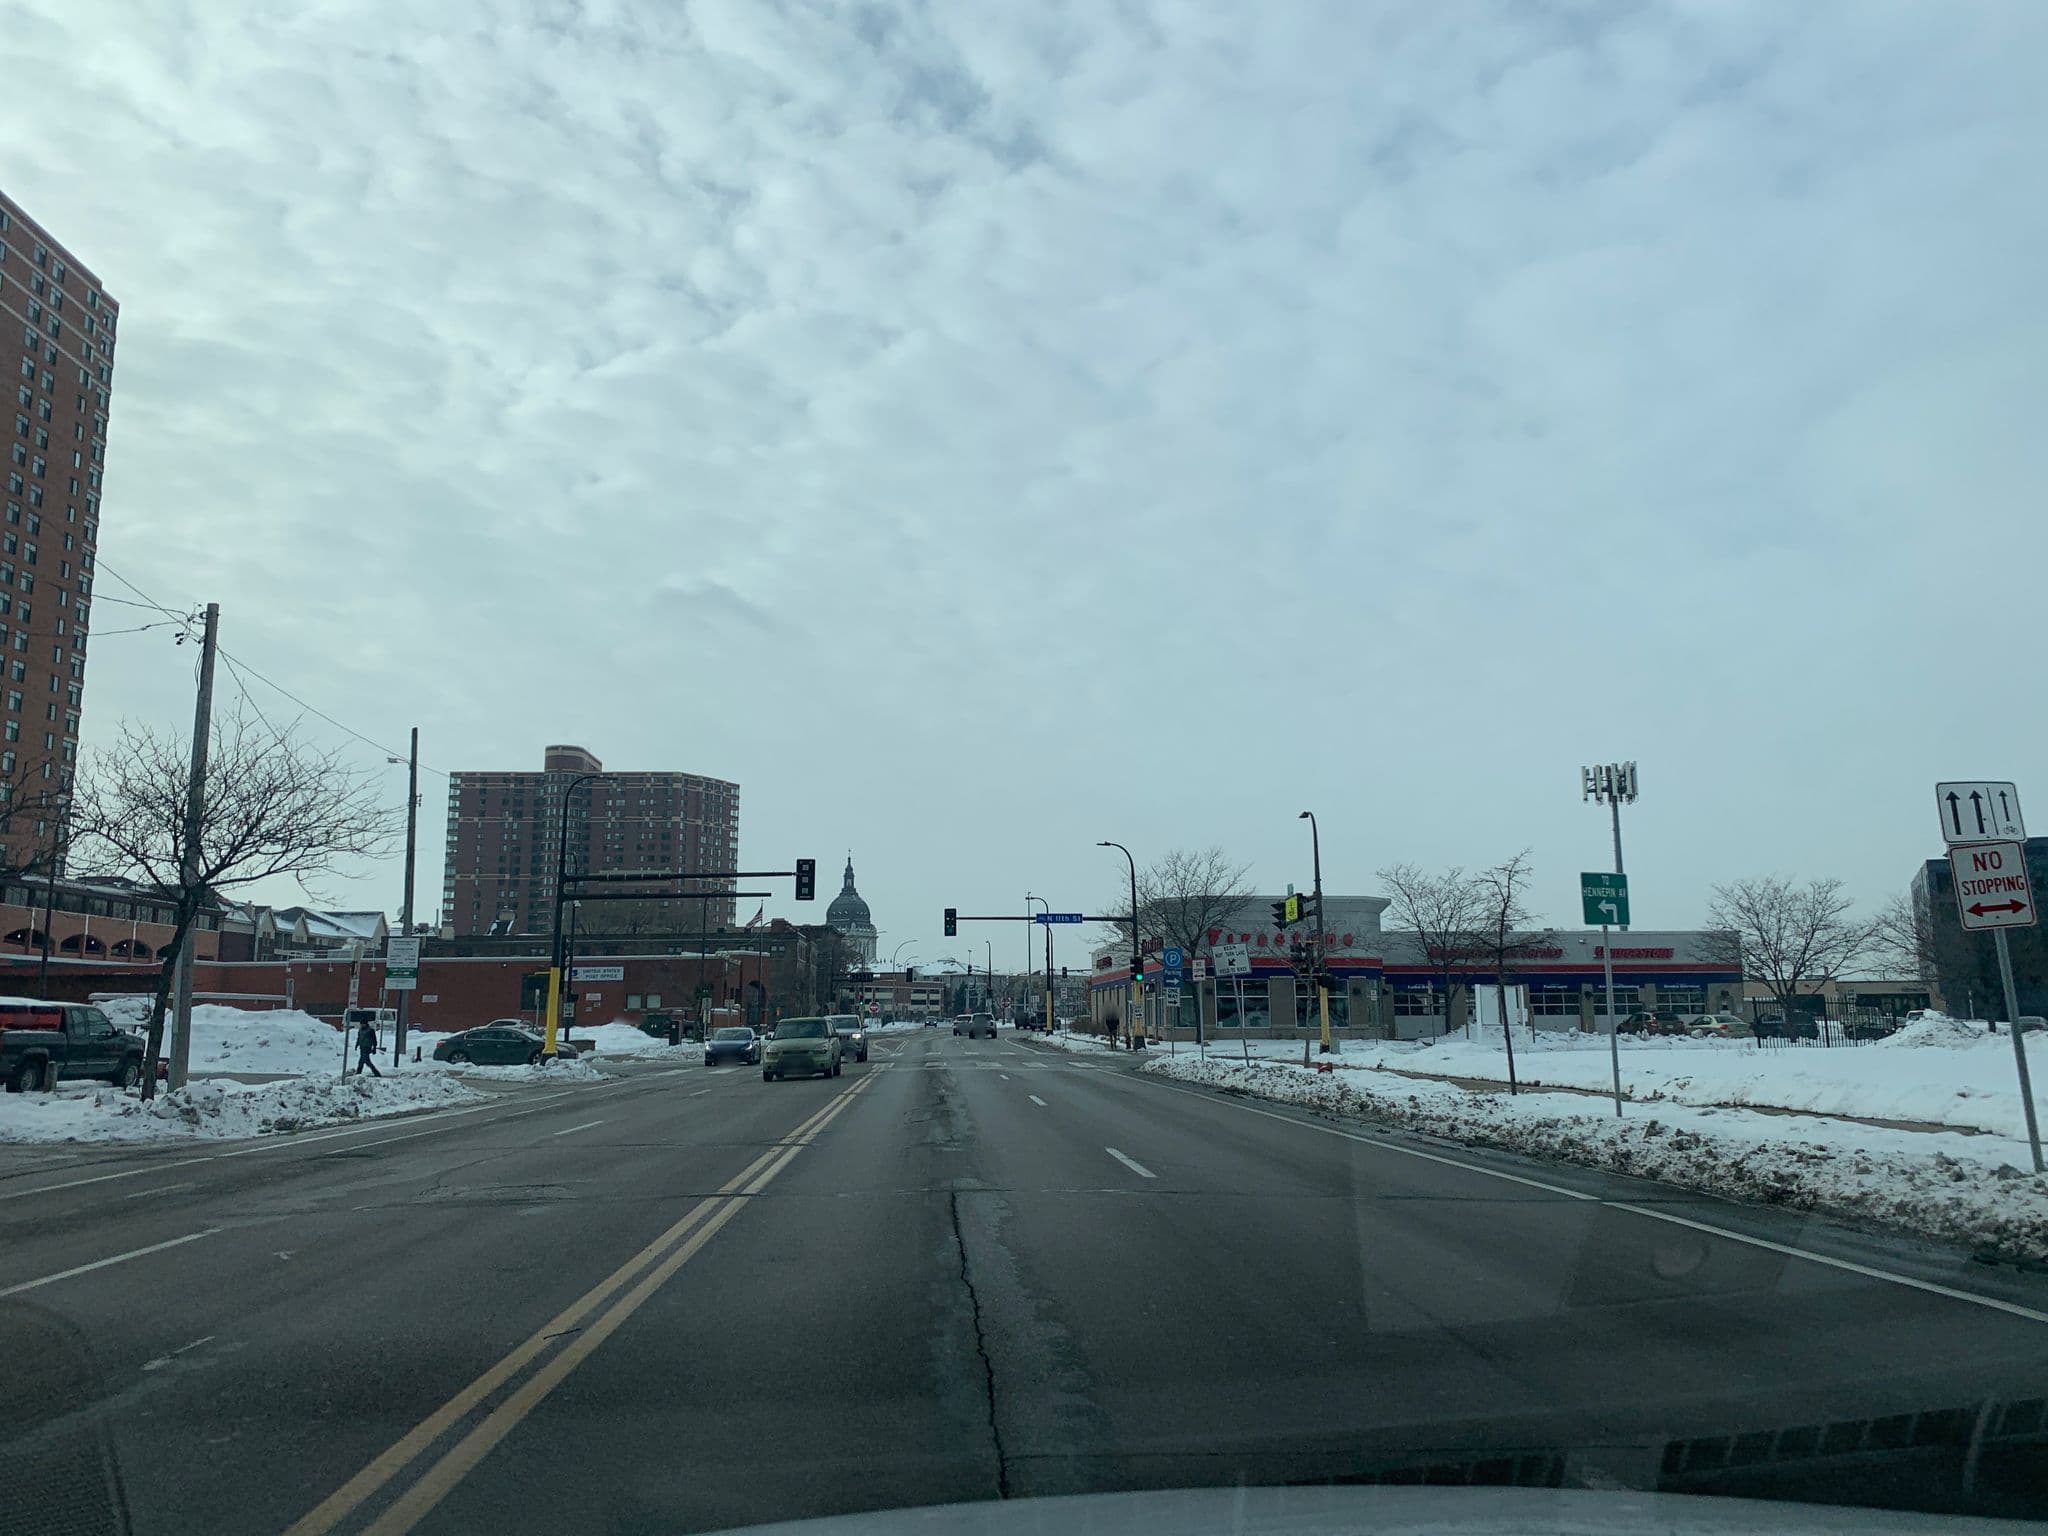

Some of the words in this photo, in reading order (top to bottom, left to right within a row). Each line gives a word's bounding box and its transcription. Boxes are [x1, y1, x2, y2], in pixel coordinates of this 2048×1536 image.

[1972, 851, 2003, 872] NO
[1601, 875, 1610, 886] TO
[1962, 875, 2025, 896] STOPPING
[1583, 887, 1617, 898] HENNEPIN
[1207, 927, 1354, 948] Firestne
[1170, 954, 1178, 963] P
